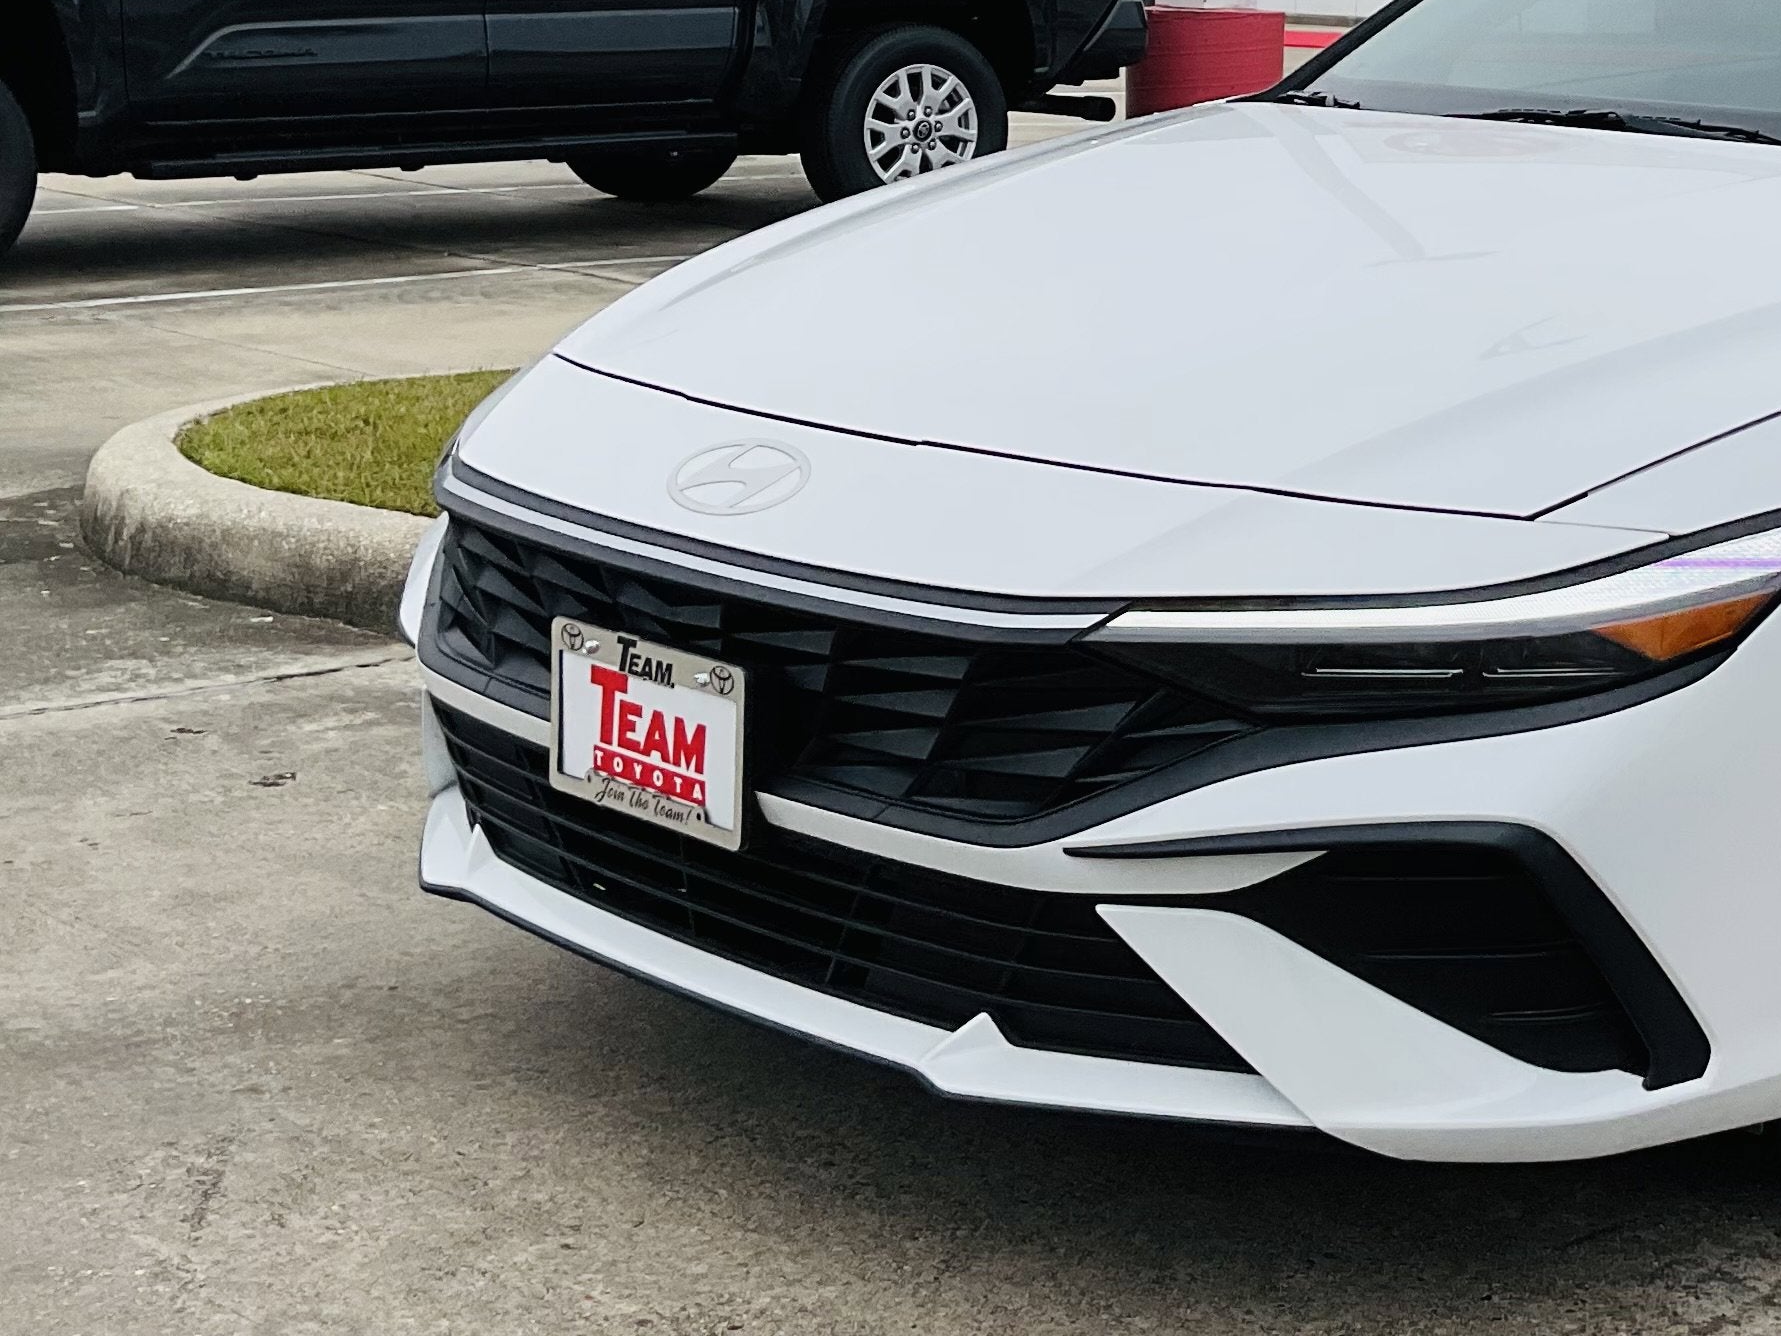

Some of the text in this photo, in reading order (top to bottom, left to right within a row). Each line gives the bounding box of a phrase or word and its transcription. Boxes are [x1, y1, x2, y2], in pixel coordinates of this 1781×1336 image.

[590, 664, 707, 775] TEAM
[594, 777, 625, 802] Join
[652, 794, 693, 825] Team!
[595, 750, 703, 801] TOYOTA
